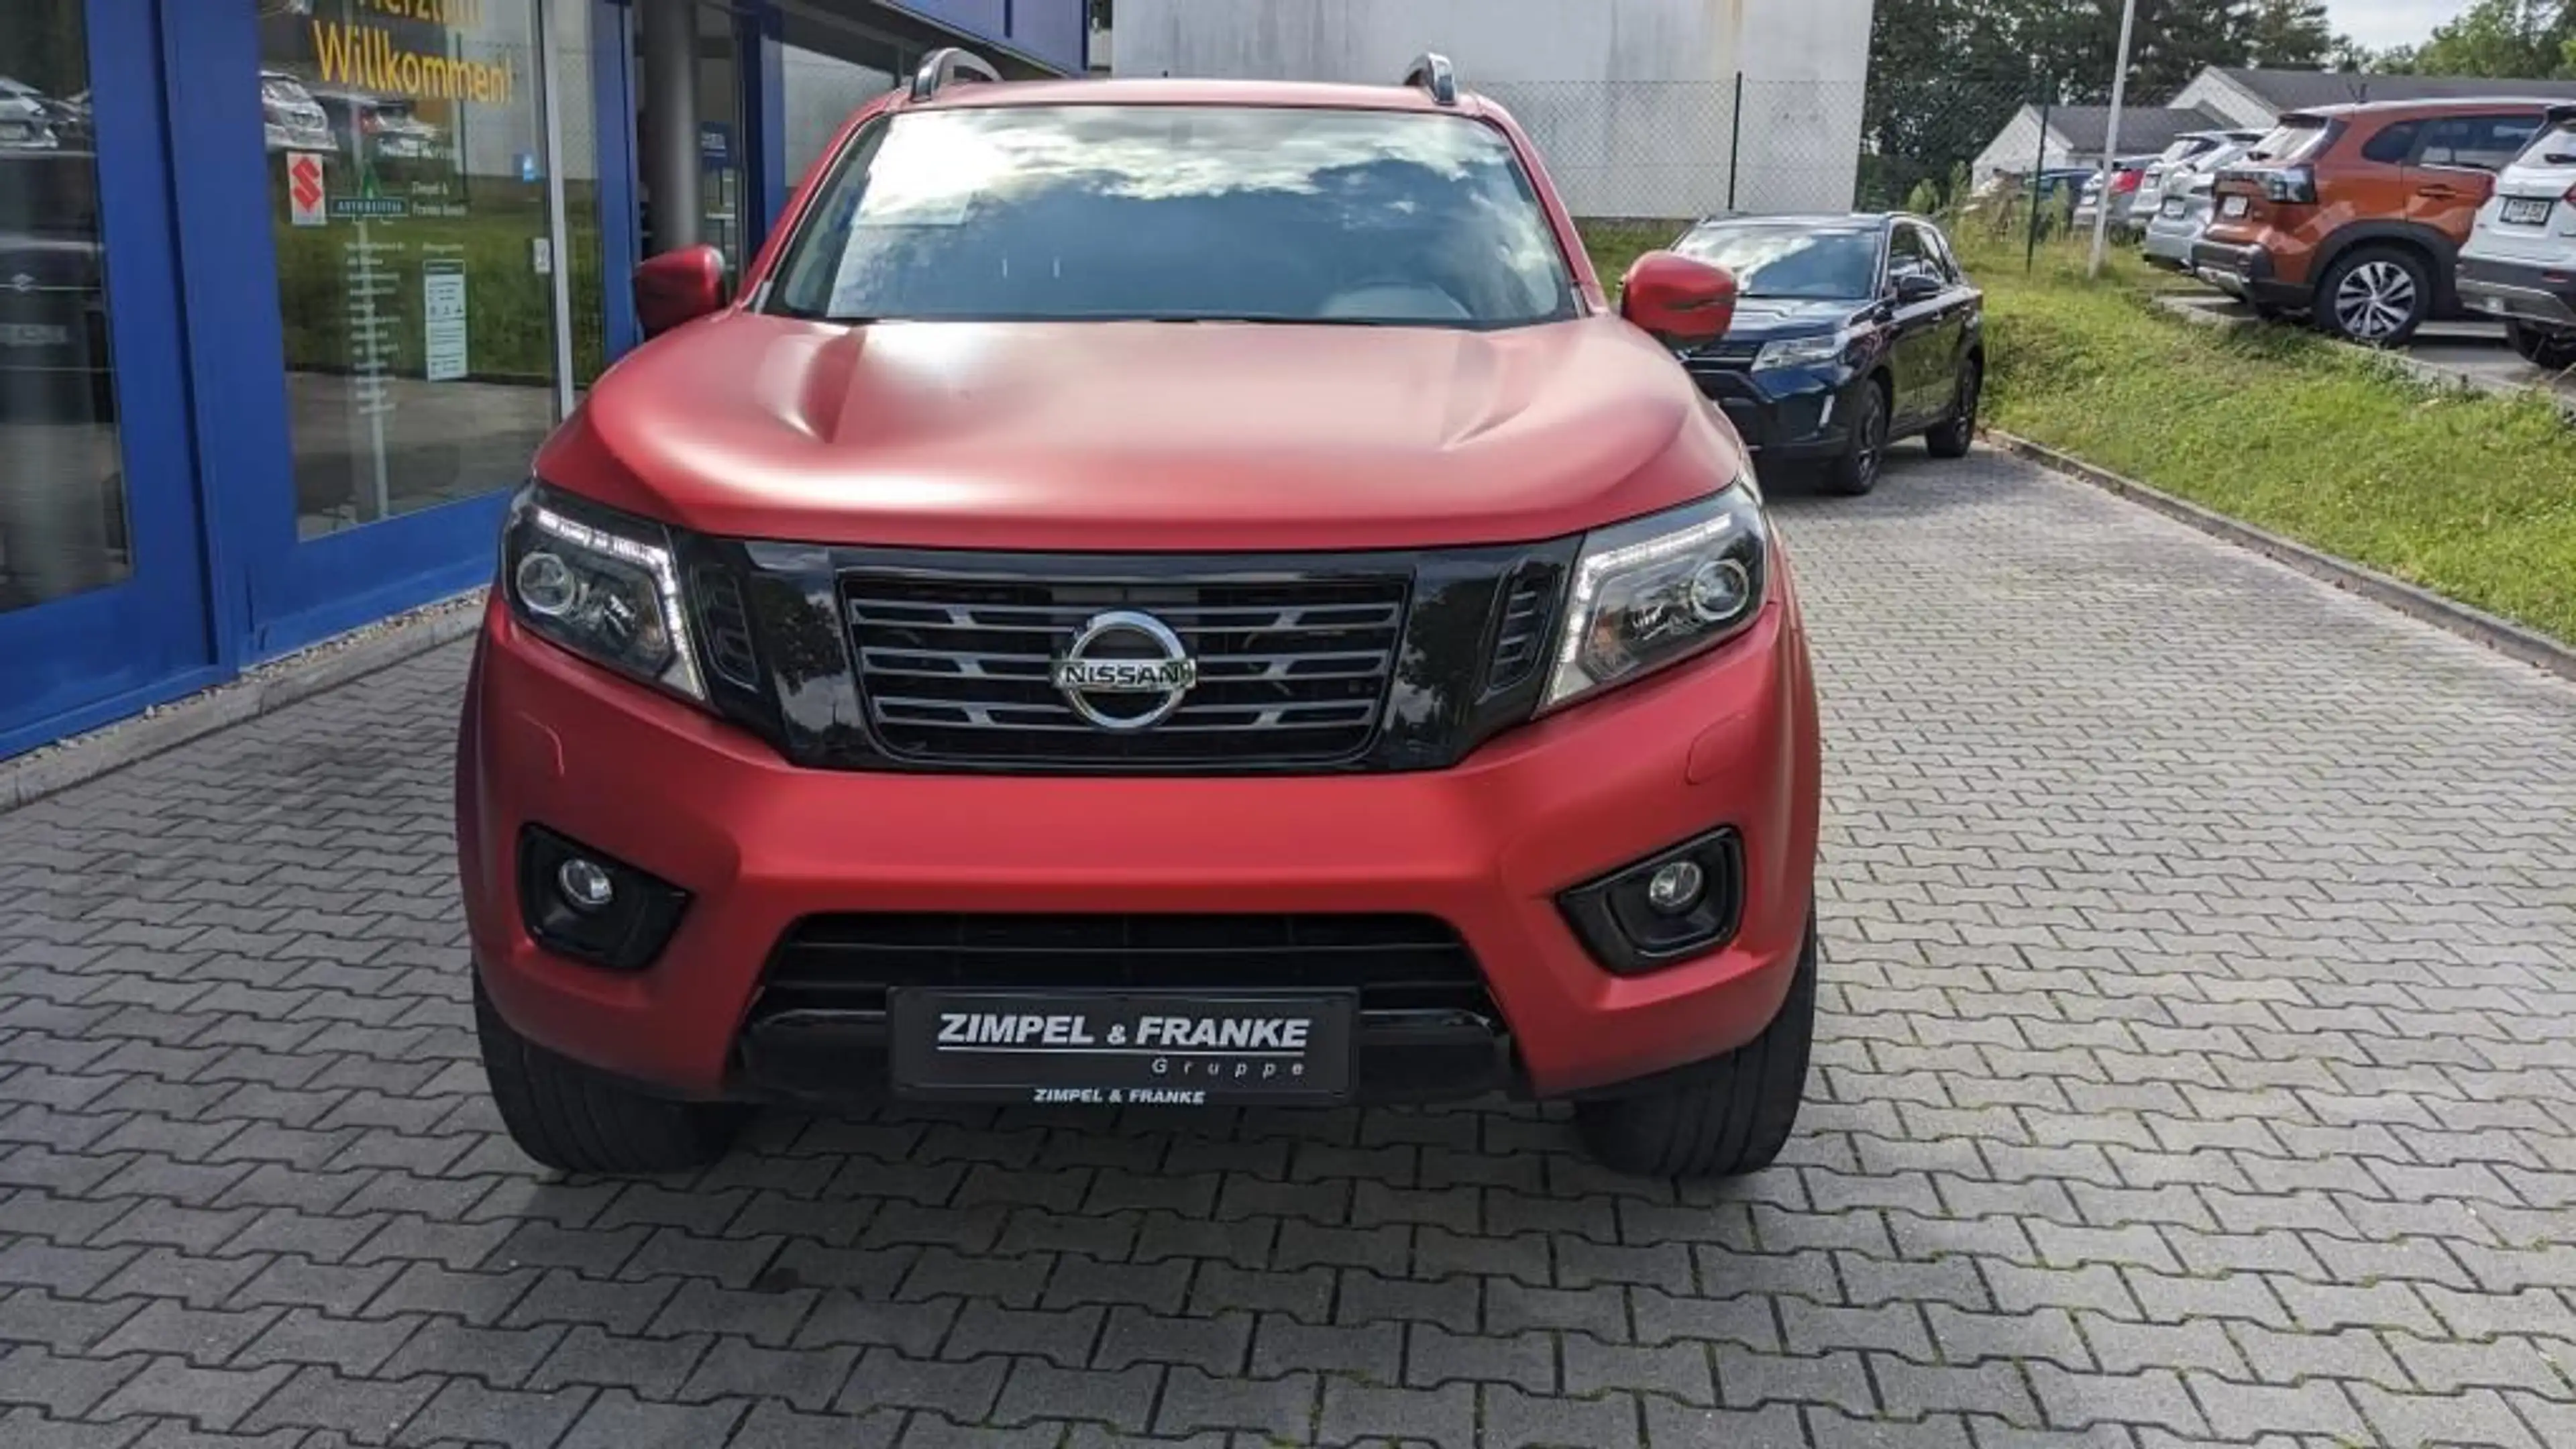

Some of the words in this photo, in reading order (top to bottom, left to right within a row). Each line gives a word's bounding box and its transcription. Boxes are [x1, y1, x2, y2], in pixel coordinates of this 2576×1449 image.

[312, 19, 512, 103] Willkommen!
[1066, 666, 1179, 684] NISSAN
[938, 1013, 1095, 1044] ZIMPEL
[1107, 1024, 1126, 1044] &
[1136, 1016, 1311, 1047] FRANKE
[1034, 1088, 1103, 1103] ZIMPEL
[1108, 1089, 1122, 1104] &
[1129, 1089, 1206, 1105] FRANKE
